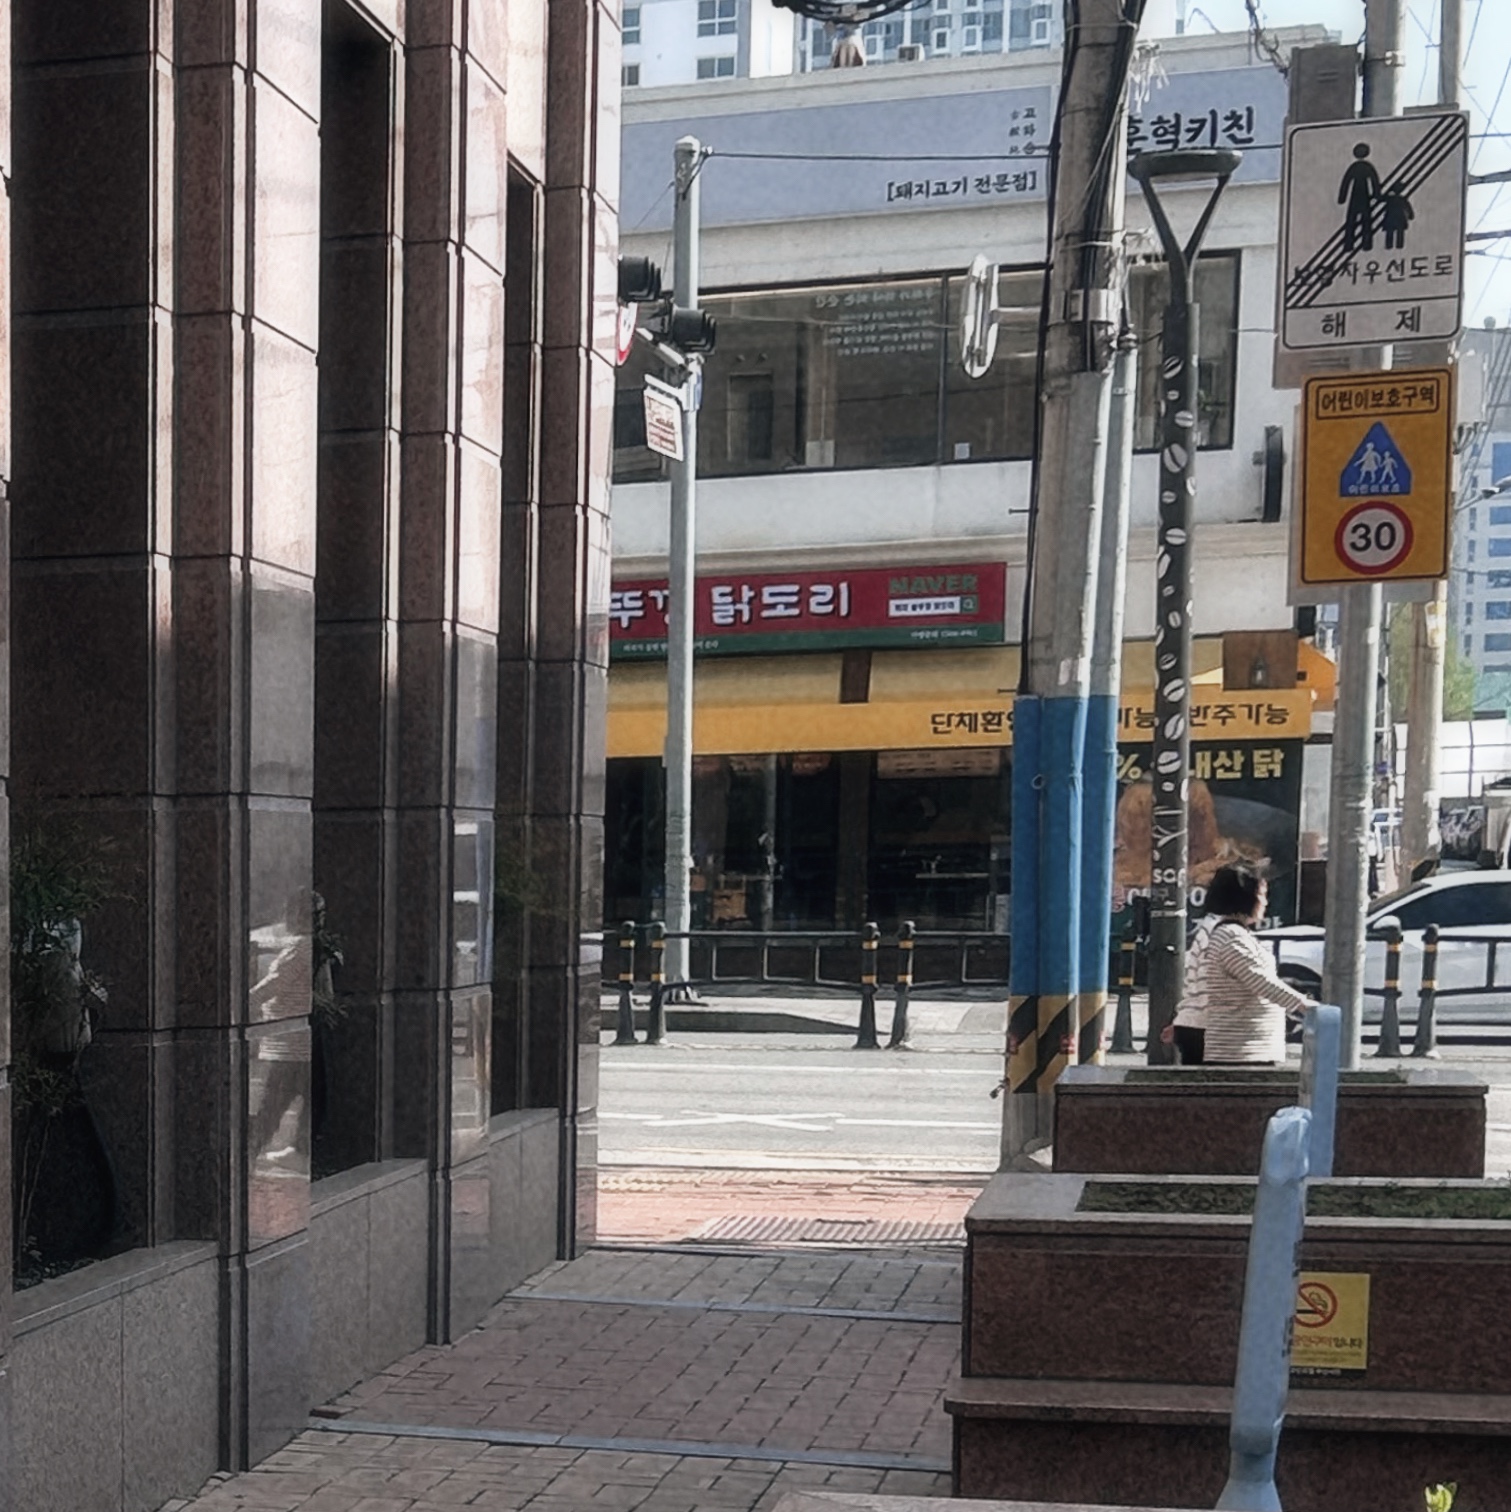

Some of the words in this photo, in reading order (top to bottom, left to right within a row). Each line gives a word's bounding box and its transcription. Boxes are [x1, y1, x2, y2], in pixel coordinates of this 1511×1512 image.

[1321, 385, 1434, 413] 어린이보호구역
[1349, 521, 1397, 552] 30
[890, 574, 978, 594] NAVER
[710, 582, 849, 626] 닭도리
[1252, 748, 1286, 778] 닭
